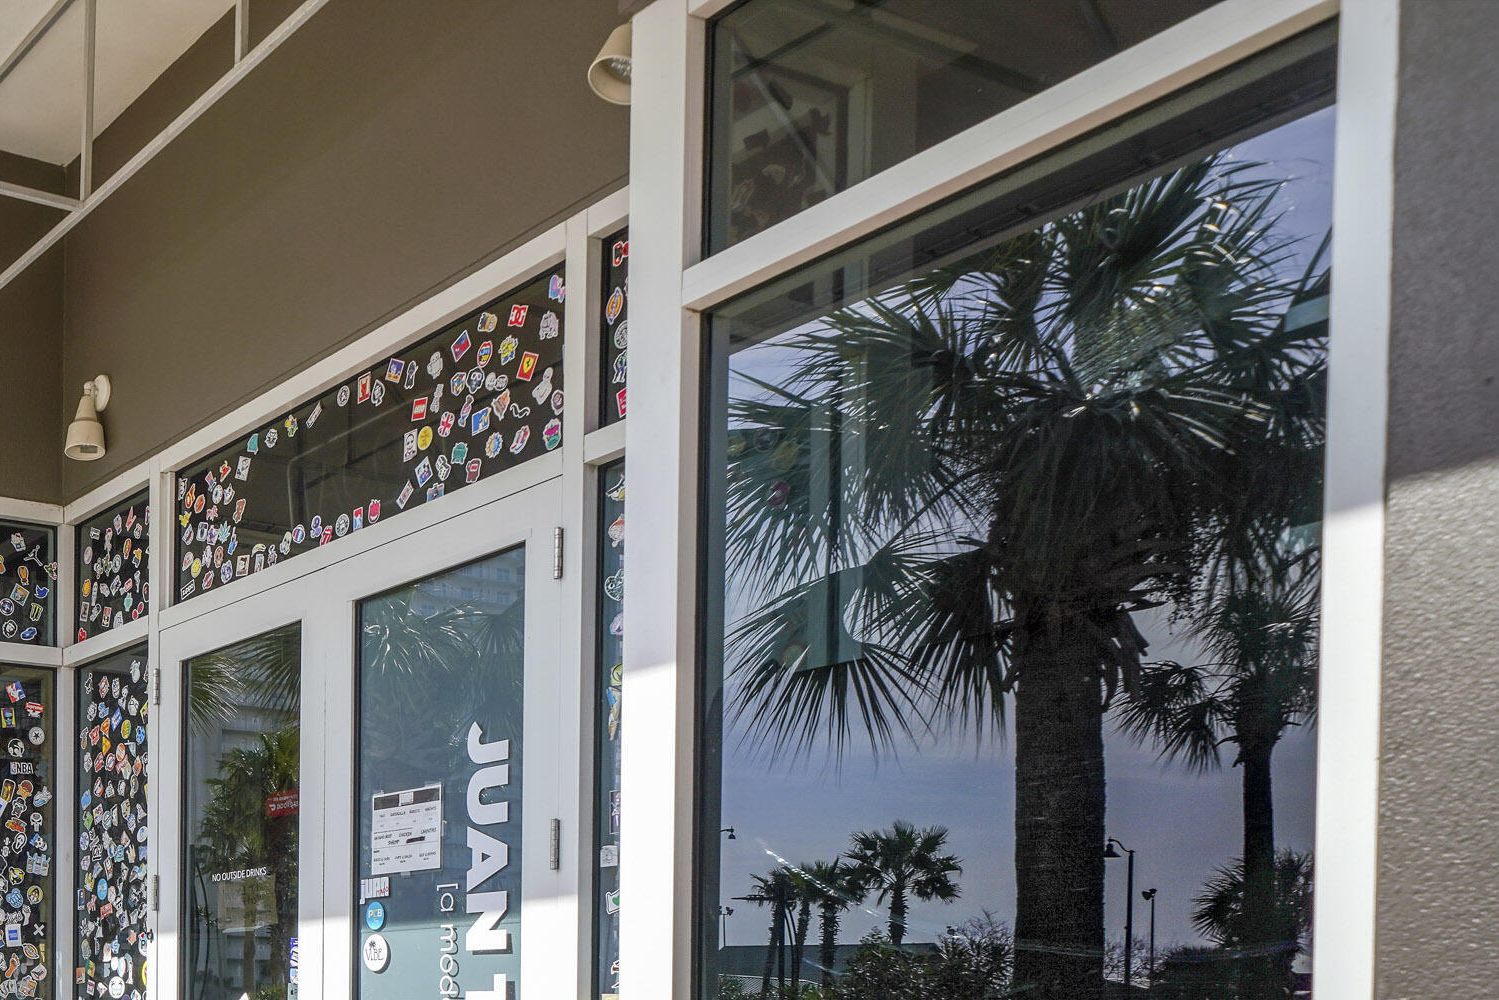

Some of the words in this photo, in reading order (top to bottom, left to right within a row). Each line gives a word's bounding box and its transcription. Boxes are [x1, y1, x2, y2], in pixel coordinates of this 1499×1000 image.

[16, 762, 33, 775] NBA
[466, 721, 509, 952] JUAN
[212, 873, 221, 882] NO
[221, 869, 245, 881] OUTSIDE
[245, 866, 267, 878] DRINKS
[368, 908, 383, 919] PCB
